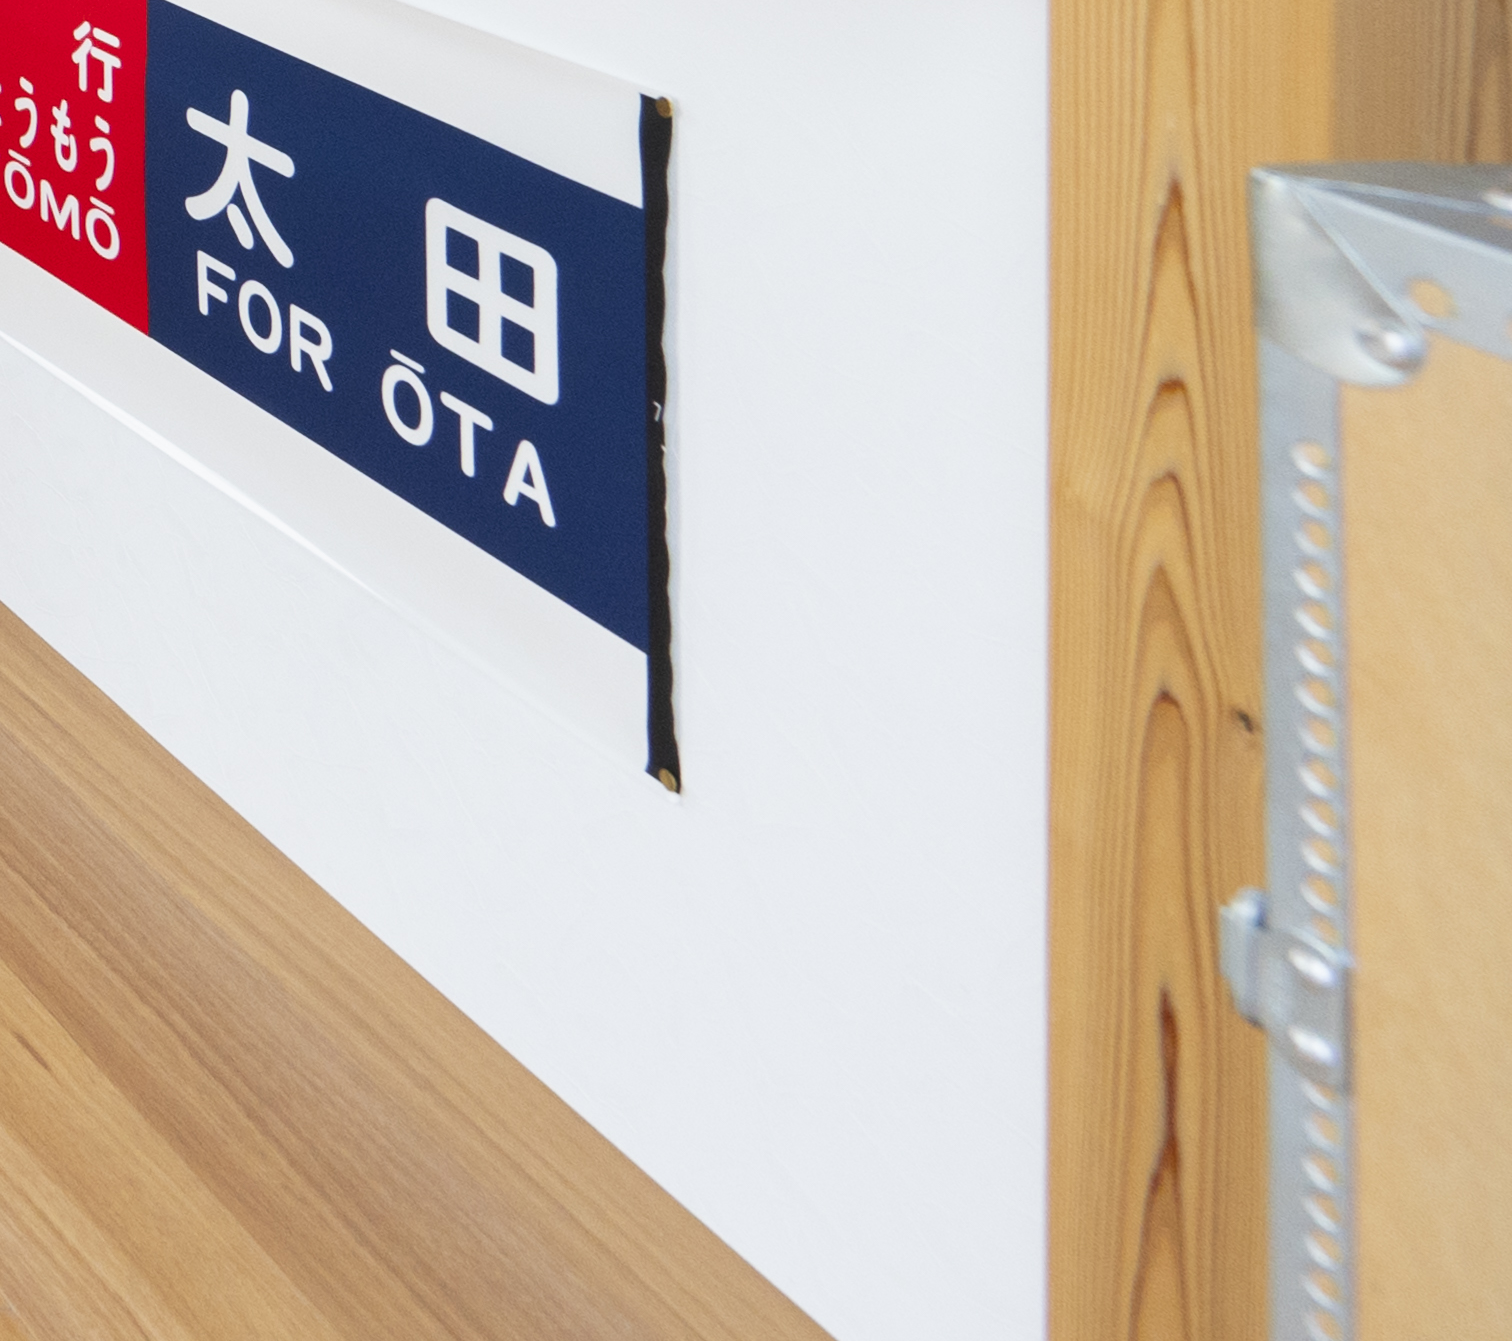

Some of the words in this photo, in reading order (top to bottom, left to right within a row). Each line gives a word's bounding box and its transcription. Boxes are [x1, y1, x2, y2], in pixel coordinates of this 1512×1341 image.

[184, 89, 559, 406] 太田
[195, 249, 334, 392] FOR
[379, 348, 557, 529] ŌTA
